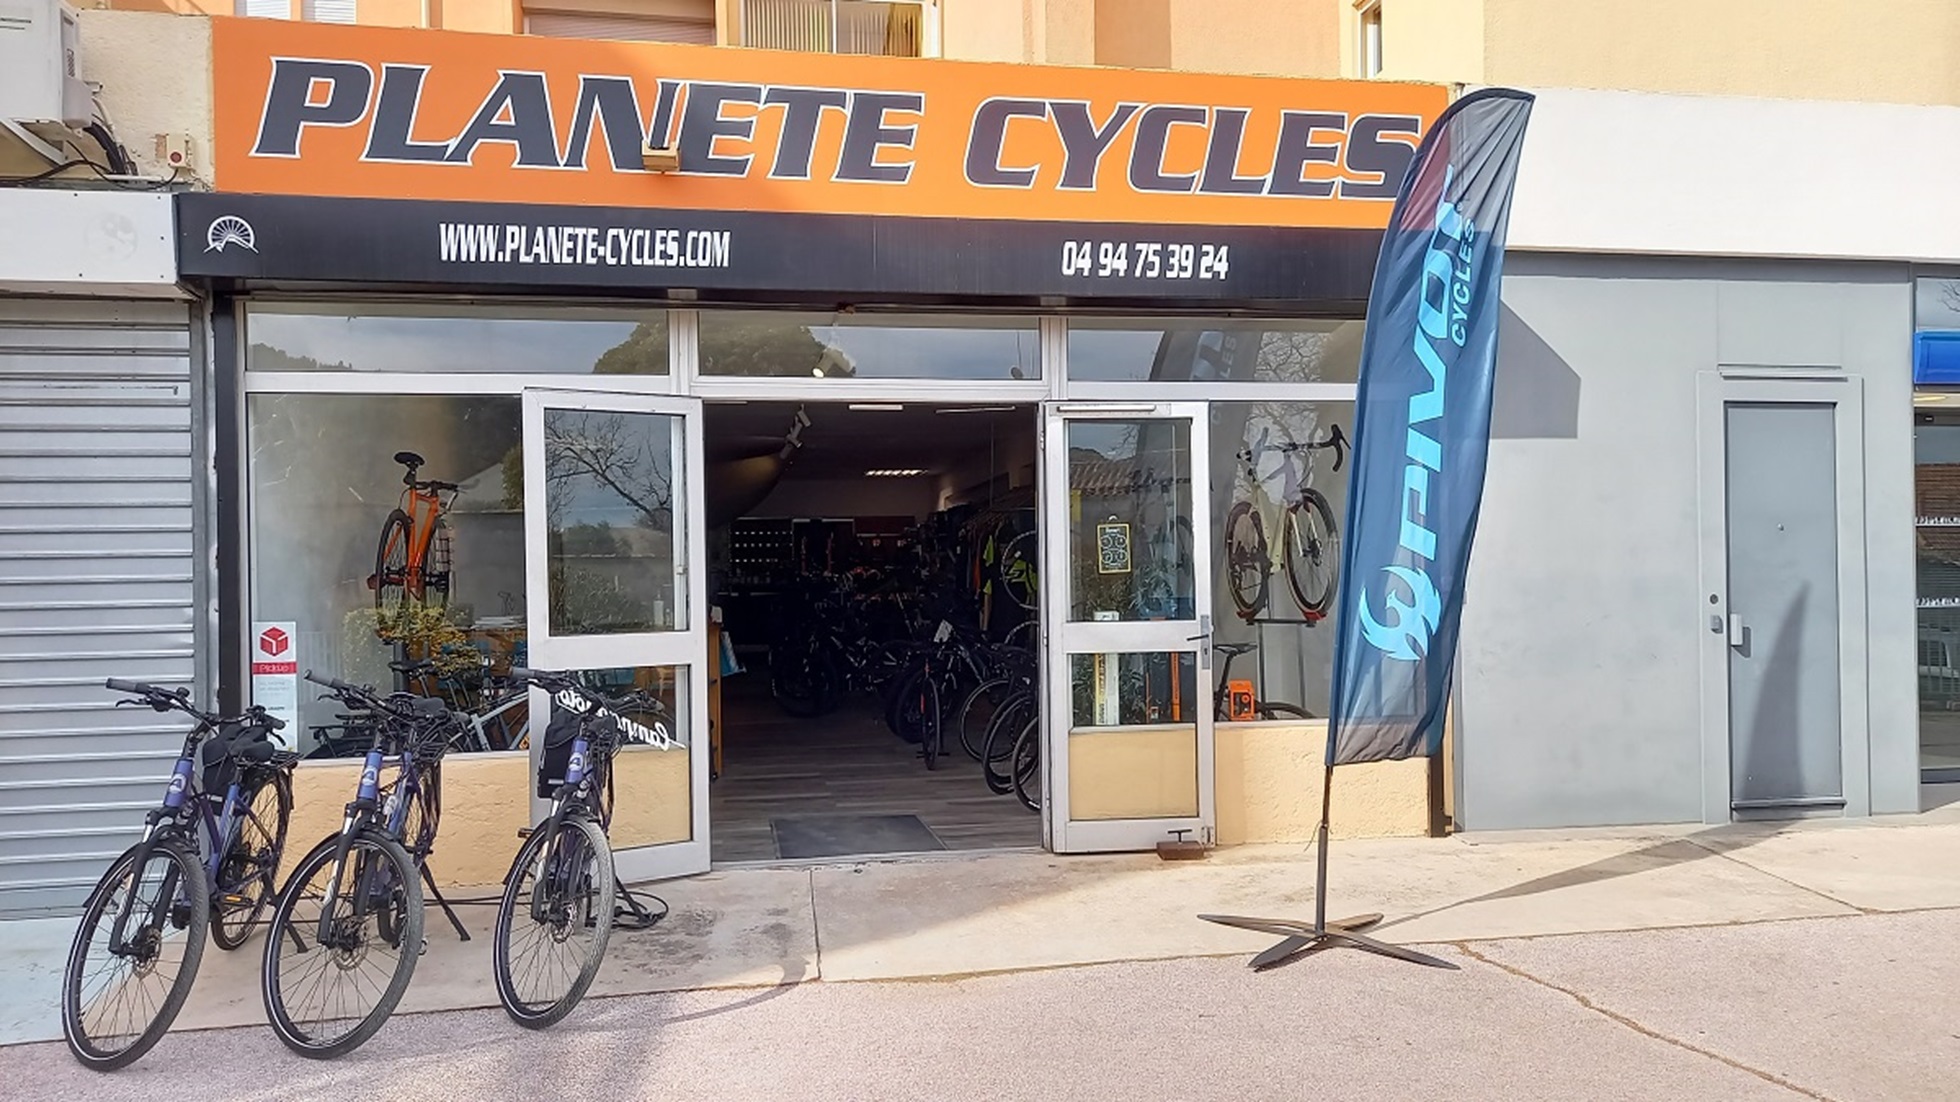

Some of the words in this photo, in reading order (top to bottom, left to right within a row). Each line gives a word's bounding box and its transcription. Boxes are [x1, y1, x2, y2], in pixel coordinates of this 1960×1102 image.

[248, 55, 926, 185] PLANETE
[963, 96, 1422, 201] CYCLES
[438, 222, 732, 268] WWW.PLANETE-CYCLES.COM
[1062, 240, 1093, 277] 04
[1098, 242, 1128, 278] 94
[1134, 243, 1162, 278] 75
[1165, 244, 1195, 279] 39
[1199, 245, 1229, 280] 24
[1451, 217, 1475, 347] CYCLES
